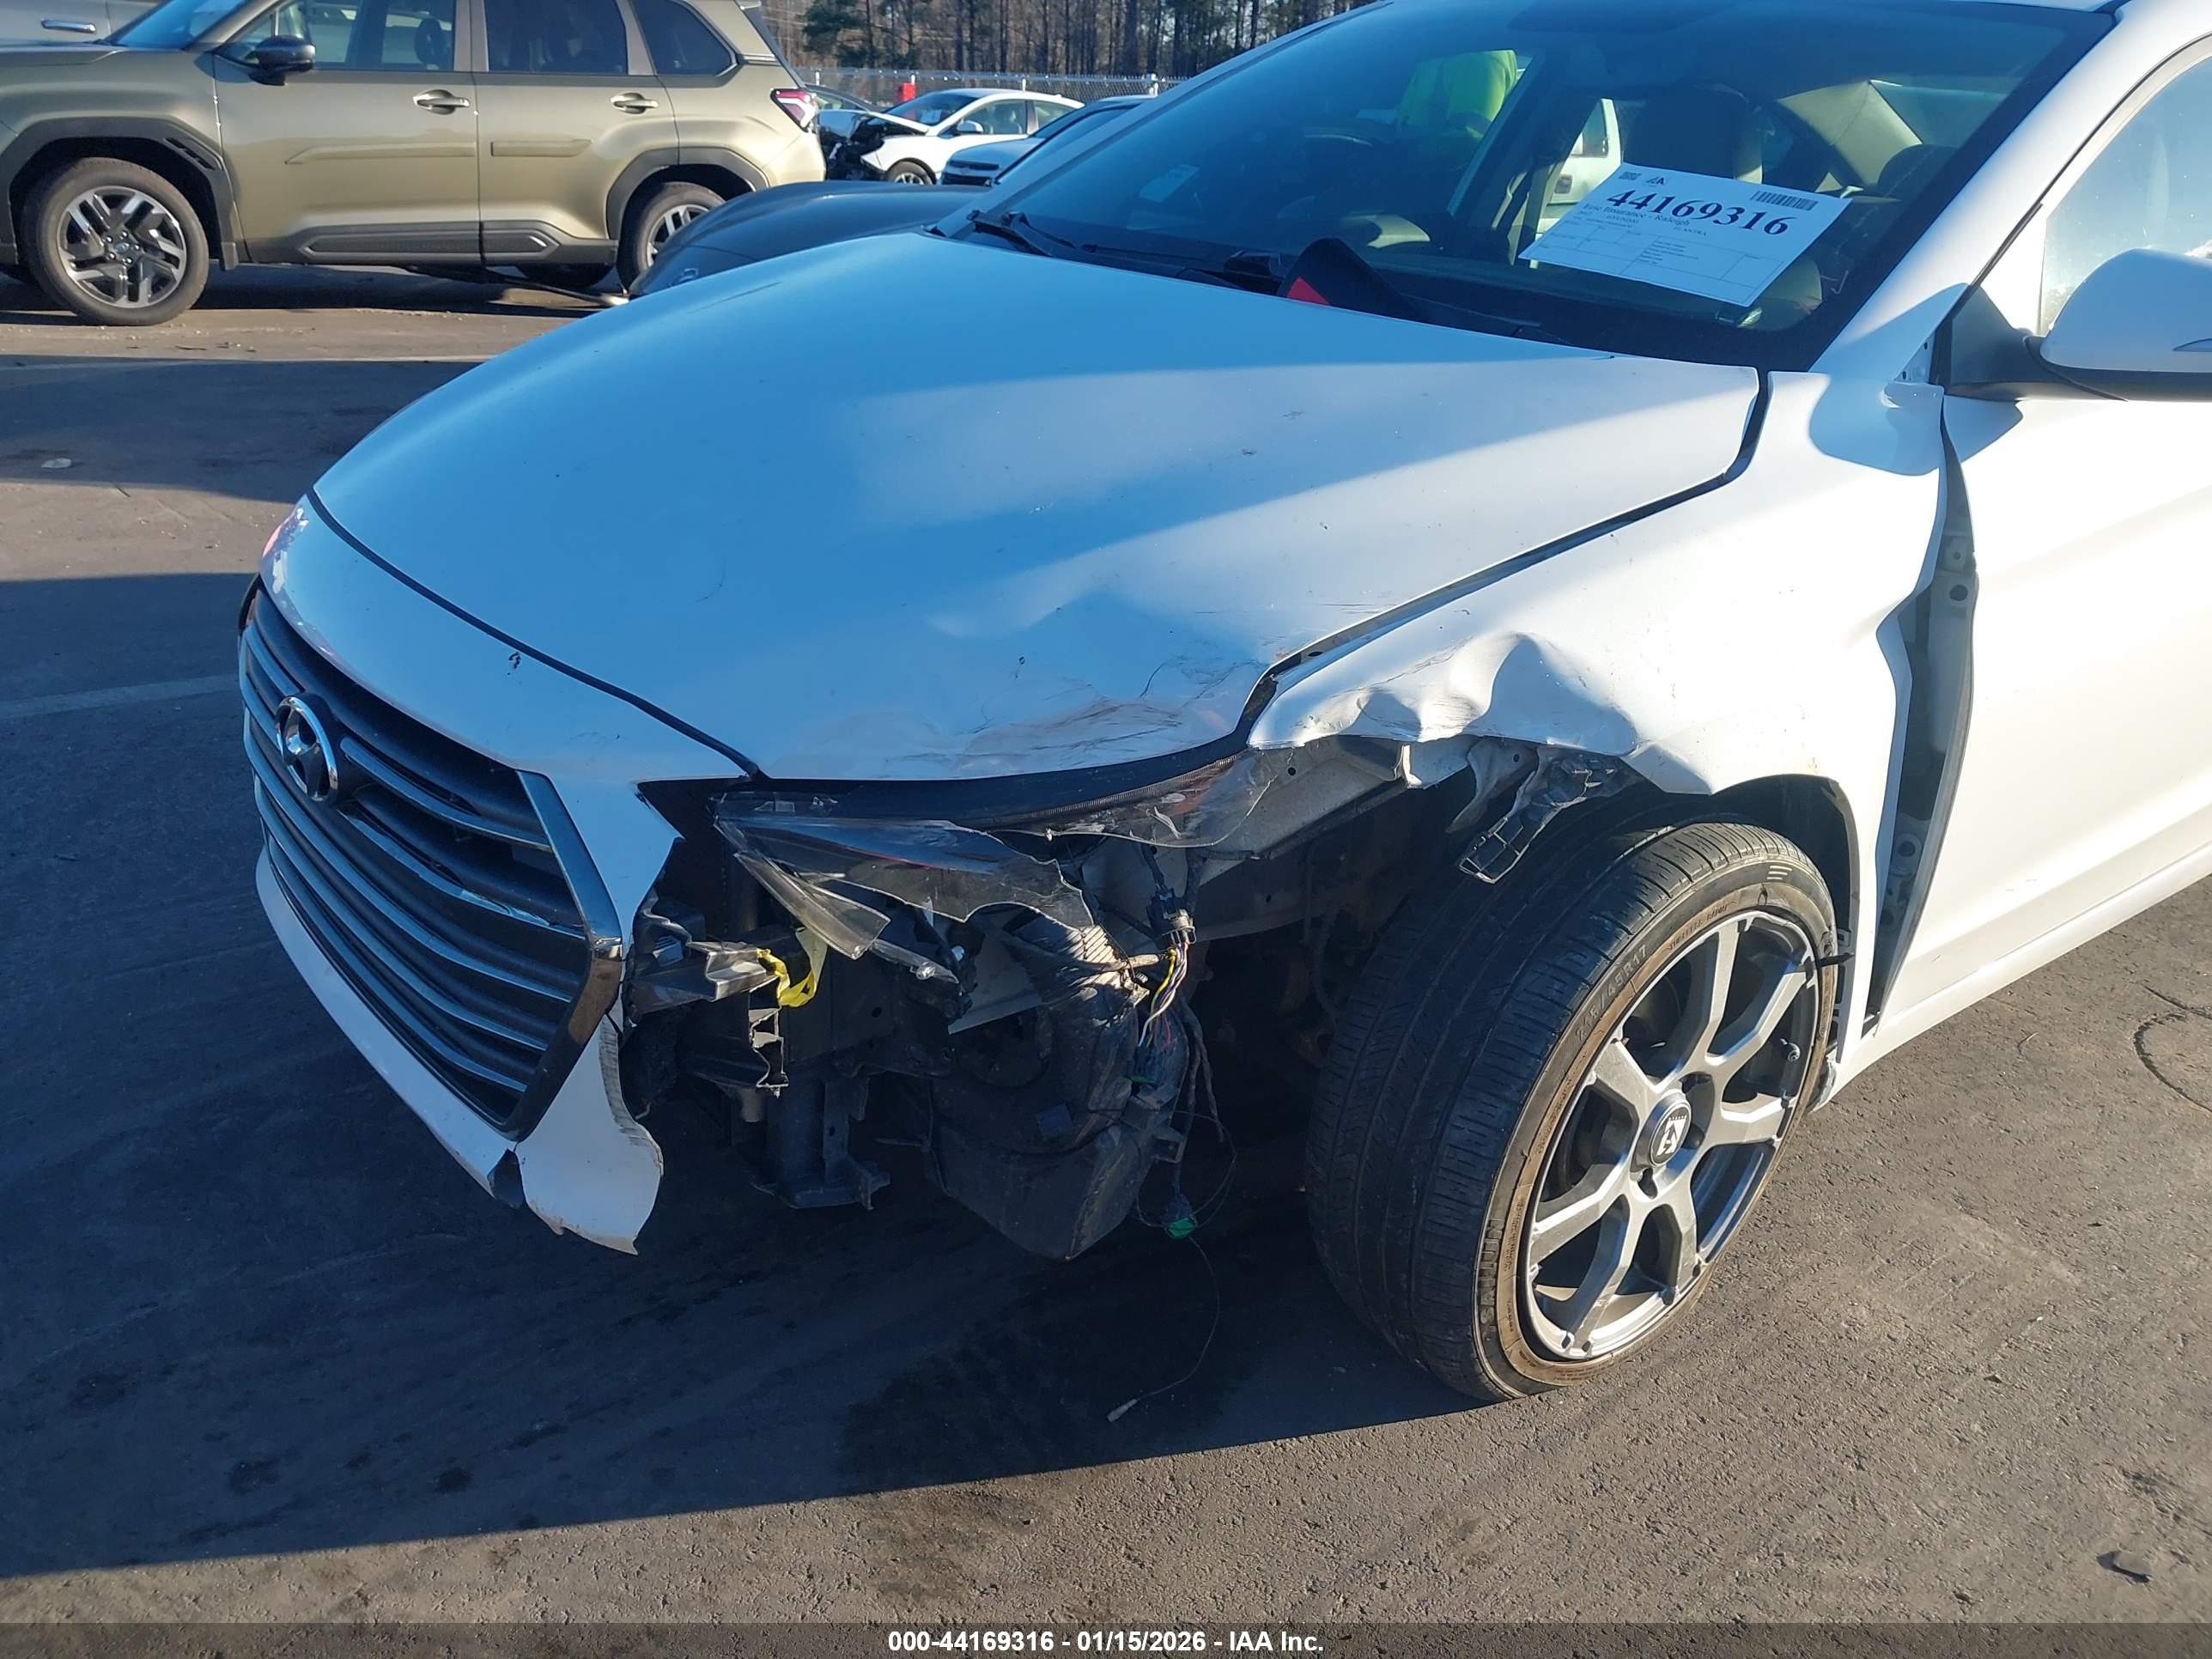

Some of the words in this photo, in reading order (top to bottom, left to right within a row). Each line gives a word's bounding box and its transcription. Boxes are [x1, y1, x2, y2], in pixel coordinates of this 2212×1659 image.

[1603, 205, 1647, 219] Insurance
[1655, 215, 1690, 226] Raleigh
[1607, 189, 1797, 235] 44169316
[1576, 945, 1646, 1042] 215/45R17
[1478, 1218, 1504, 1324] SAILUN
